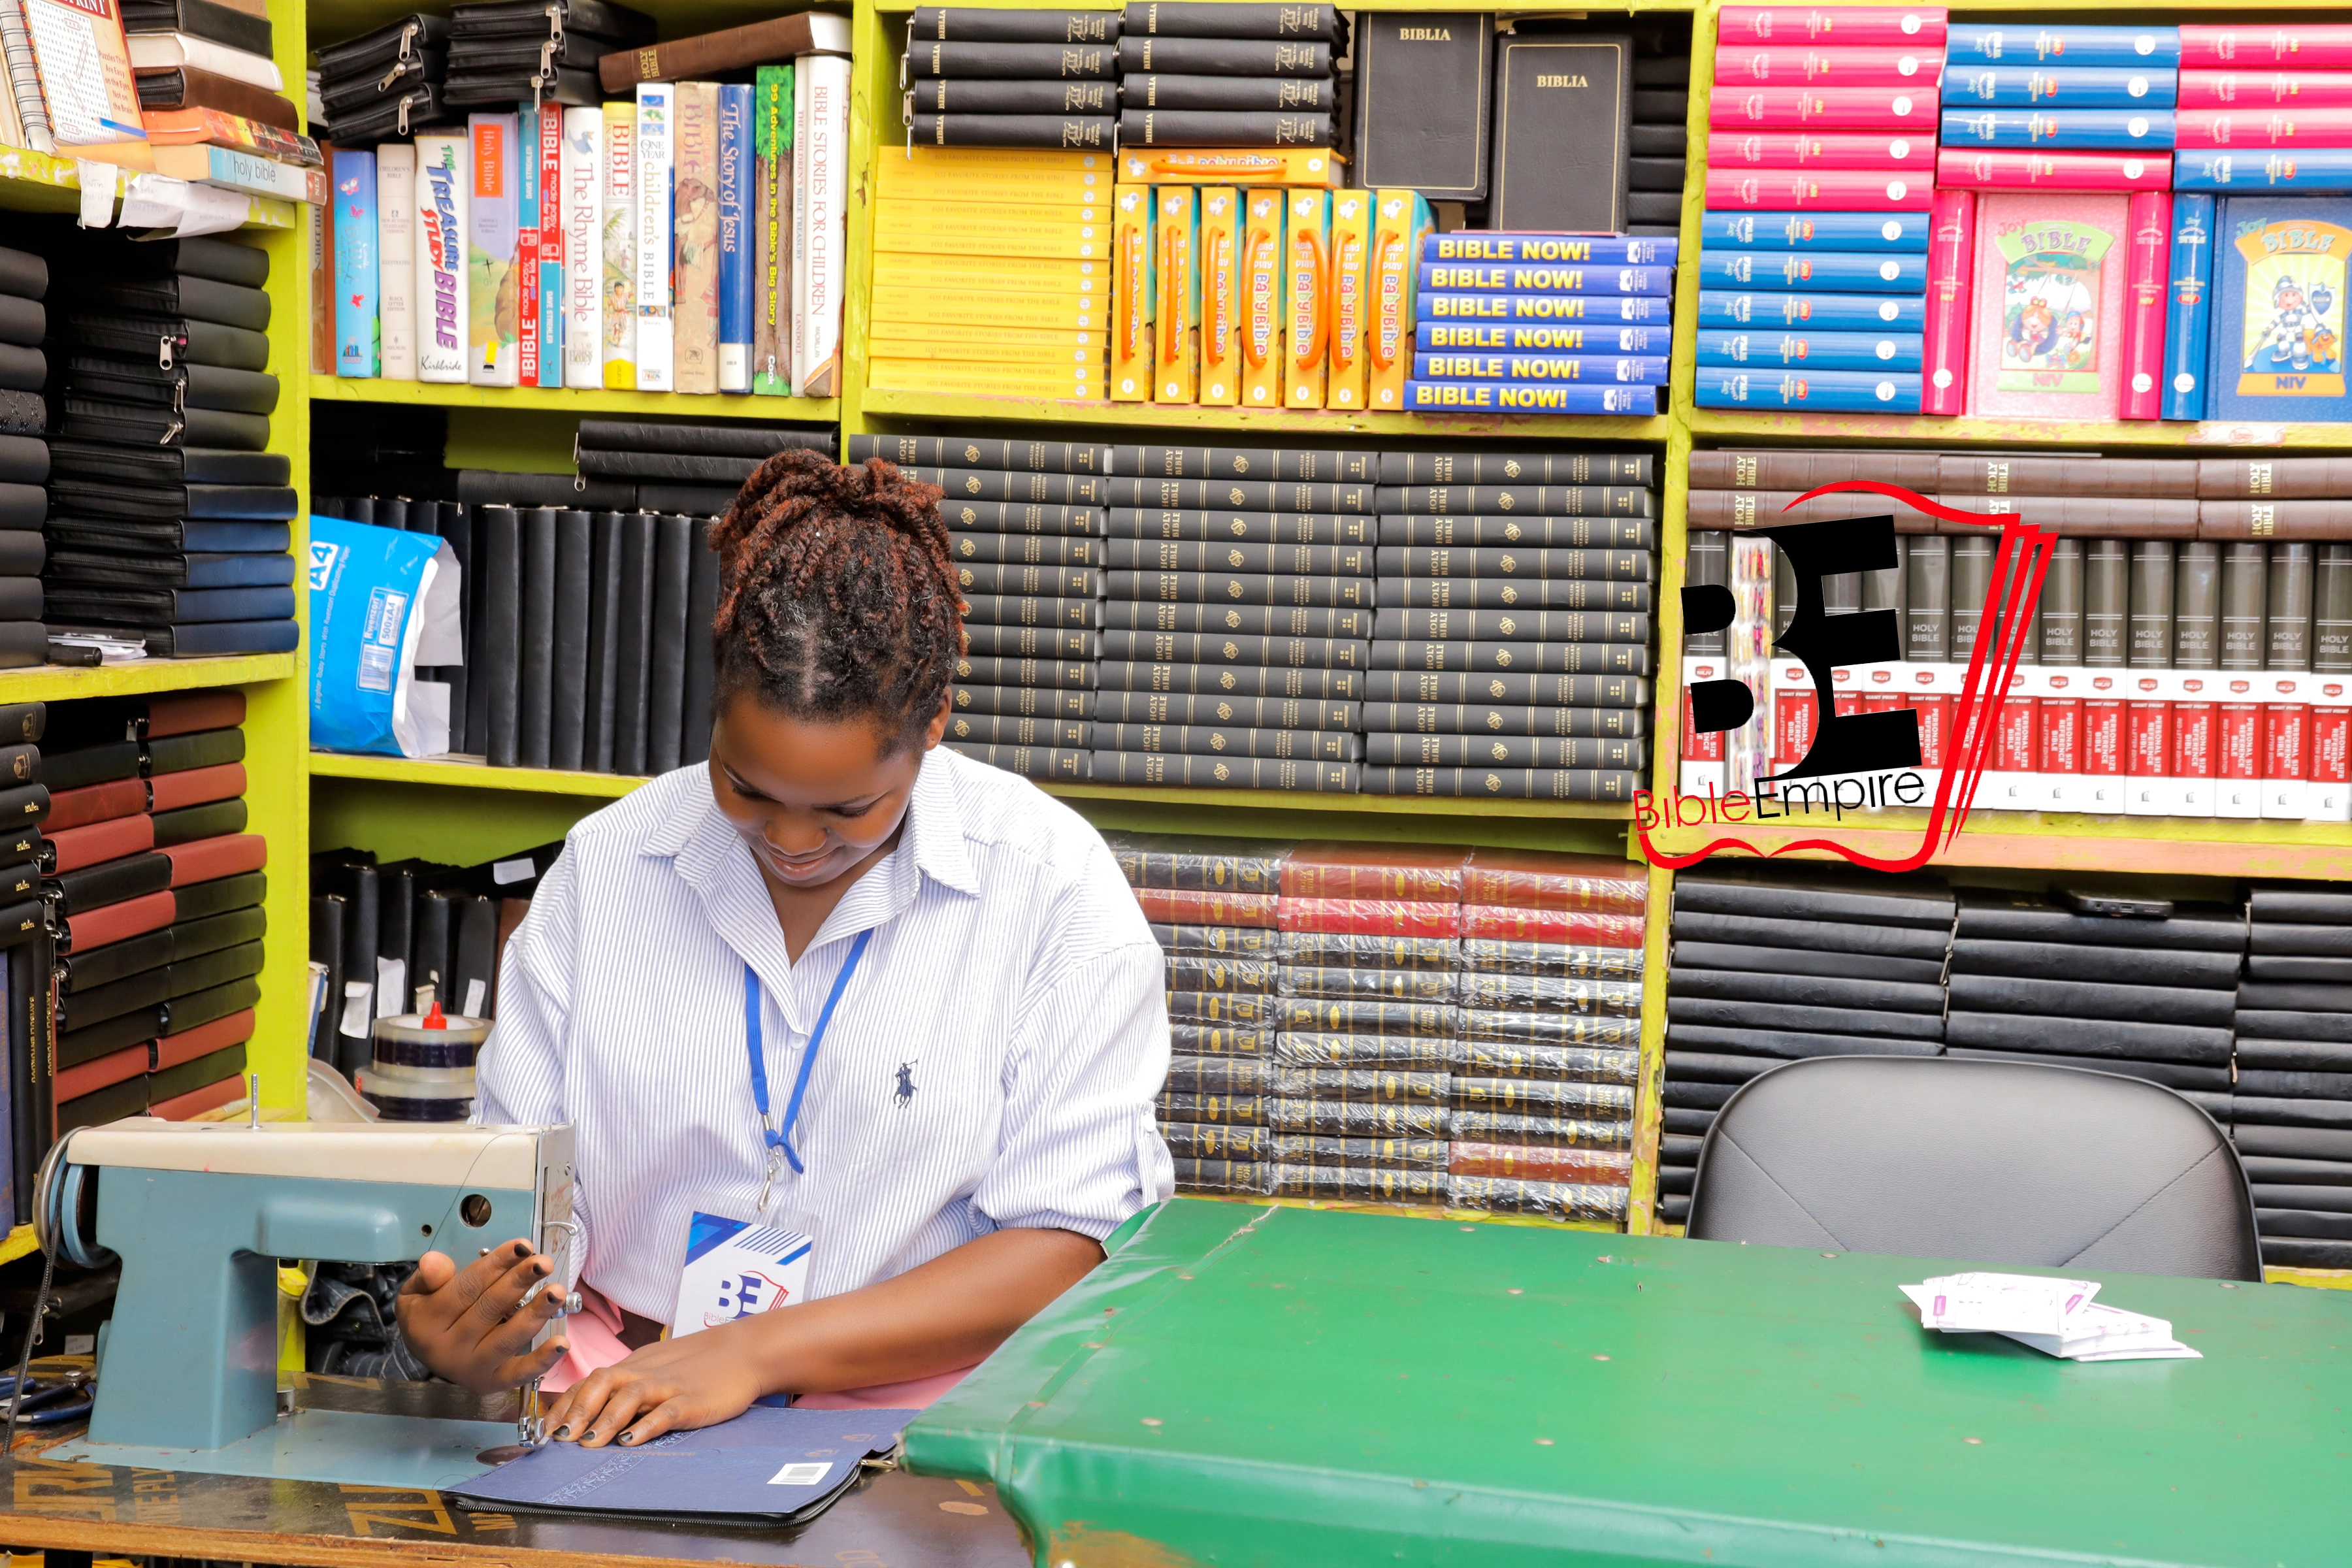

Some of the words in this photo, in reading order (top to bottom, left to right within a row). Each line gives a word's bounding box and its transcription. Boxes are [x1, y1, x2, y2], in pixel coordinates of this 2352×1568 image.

[1149, 4, 1157, 33] BIBLIA
[1399, 27, 1451, 41] BIBLIA
[99, 50, 115, 62] Puzzles
[115, 56, 127, 65] That
[106, 65, 114, 74] Are
[115, 67, 125, 78] Easy
[640, 51, 651, 79] HOLY
[648, 49, 660, 77] BIBLE
[932, 44, 941, 74] BIBLIA
[771, 84, 778, 102] 99
[1536, 75, 1588, 88] BIBLIA
[121, 105, 133, 114] Brain
[814, 86, 827, 125] BIBLE
[722, 103, 742, 140] The
[482, 130, 494, 156] Holy
[543, 118, 557, 171] BIBLE
[641, 140, 664, 149] ONE
[683, 104, 704, 174] BIBLE
[770, 106, 779, 180] Adventures
[233, 155, 252, 182] holy
[255, 161, 276, 183] bible
[440, 145, 457, 171] THE
[613, 123, 629, 196] BIBLE
[640, 150, 665, 159] YEAR
[717, 145, 740, 188] Story
[813, 132, 827, 195] STORIES
[483, 159, 494, 191] Bible
[574, 166, 589, 201] The
[770, 183, 778, 195] in
[644, 161, 661, 245] children's
[718, 193, 741, 210] of
[813, 201, 826, 232] FOR
[426, 162, 459, 272] TREASURE
[718, 212, 741, 252] Jesus
[2236, 218, 2268, 238] Joy
[568, 206, 595, 272] Rhyme
[769, 221, 778, 263] Bible's
[1439, 240, 1514, 259] BIBLE
[1522, 241, 1590, 261] NOW!
[2021, 231, 2092, 253] BIBLE
[2261, 229, 2335, 253] BIBLE
[420, 206, 444, 272] STUDY
[434, 269, 457, 350] BIBLE
[644, 252, 654, 300] BIBLE
[768, 266, 777, 287] Big
[811, 235, 826, 316] CHILDREN
[1431, 269, 1507, 287] BIBLE
[1514, 270, 1582, 289] NOW!
[574, 276, 595, 322] Bible
[1296, 273, 1314, 312] Baby
[1382, 275, 1400, 314] Baby
[768, 291, 777, 325] Story
[522, 318, 536, 370] BIBLE
[1296, 314, 1315, 355] Bible
[1382, 316, 1400, 358] Bible
[1431, 327, 1507, 346] BIBLE
[1514, 329, 1582, 348] NOW!
[420, 355, 462, 371] Kirkbride
[2033, 373, 2063, 387] NIV
[2276, 376, 2307, 389] NIV
[1416, 386, 1491, 405] BIBLE
[1499, 388, 1567, 408] NOW!
[899, 438, 907, 464] HOLY
[1736, 456, 1746, 485] HOLY
[1746, 457, 1757, 485] BIBLE
[2251, 504, 2262, 535] HOLY
[2263, 505, 2274, 535] BIBLE
[310, 546, 333, 588] A4
[323, 596, 335, 625] Rwenzori
[329, 563, 346, 596] Duplicating
[338, 546, 351, 563] Paper
[364, 598, 380, 639] Rwenzori
[382, 602, 396, 640] 500xA4
